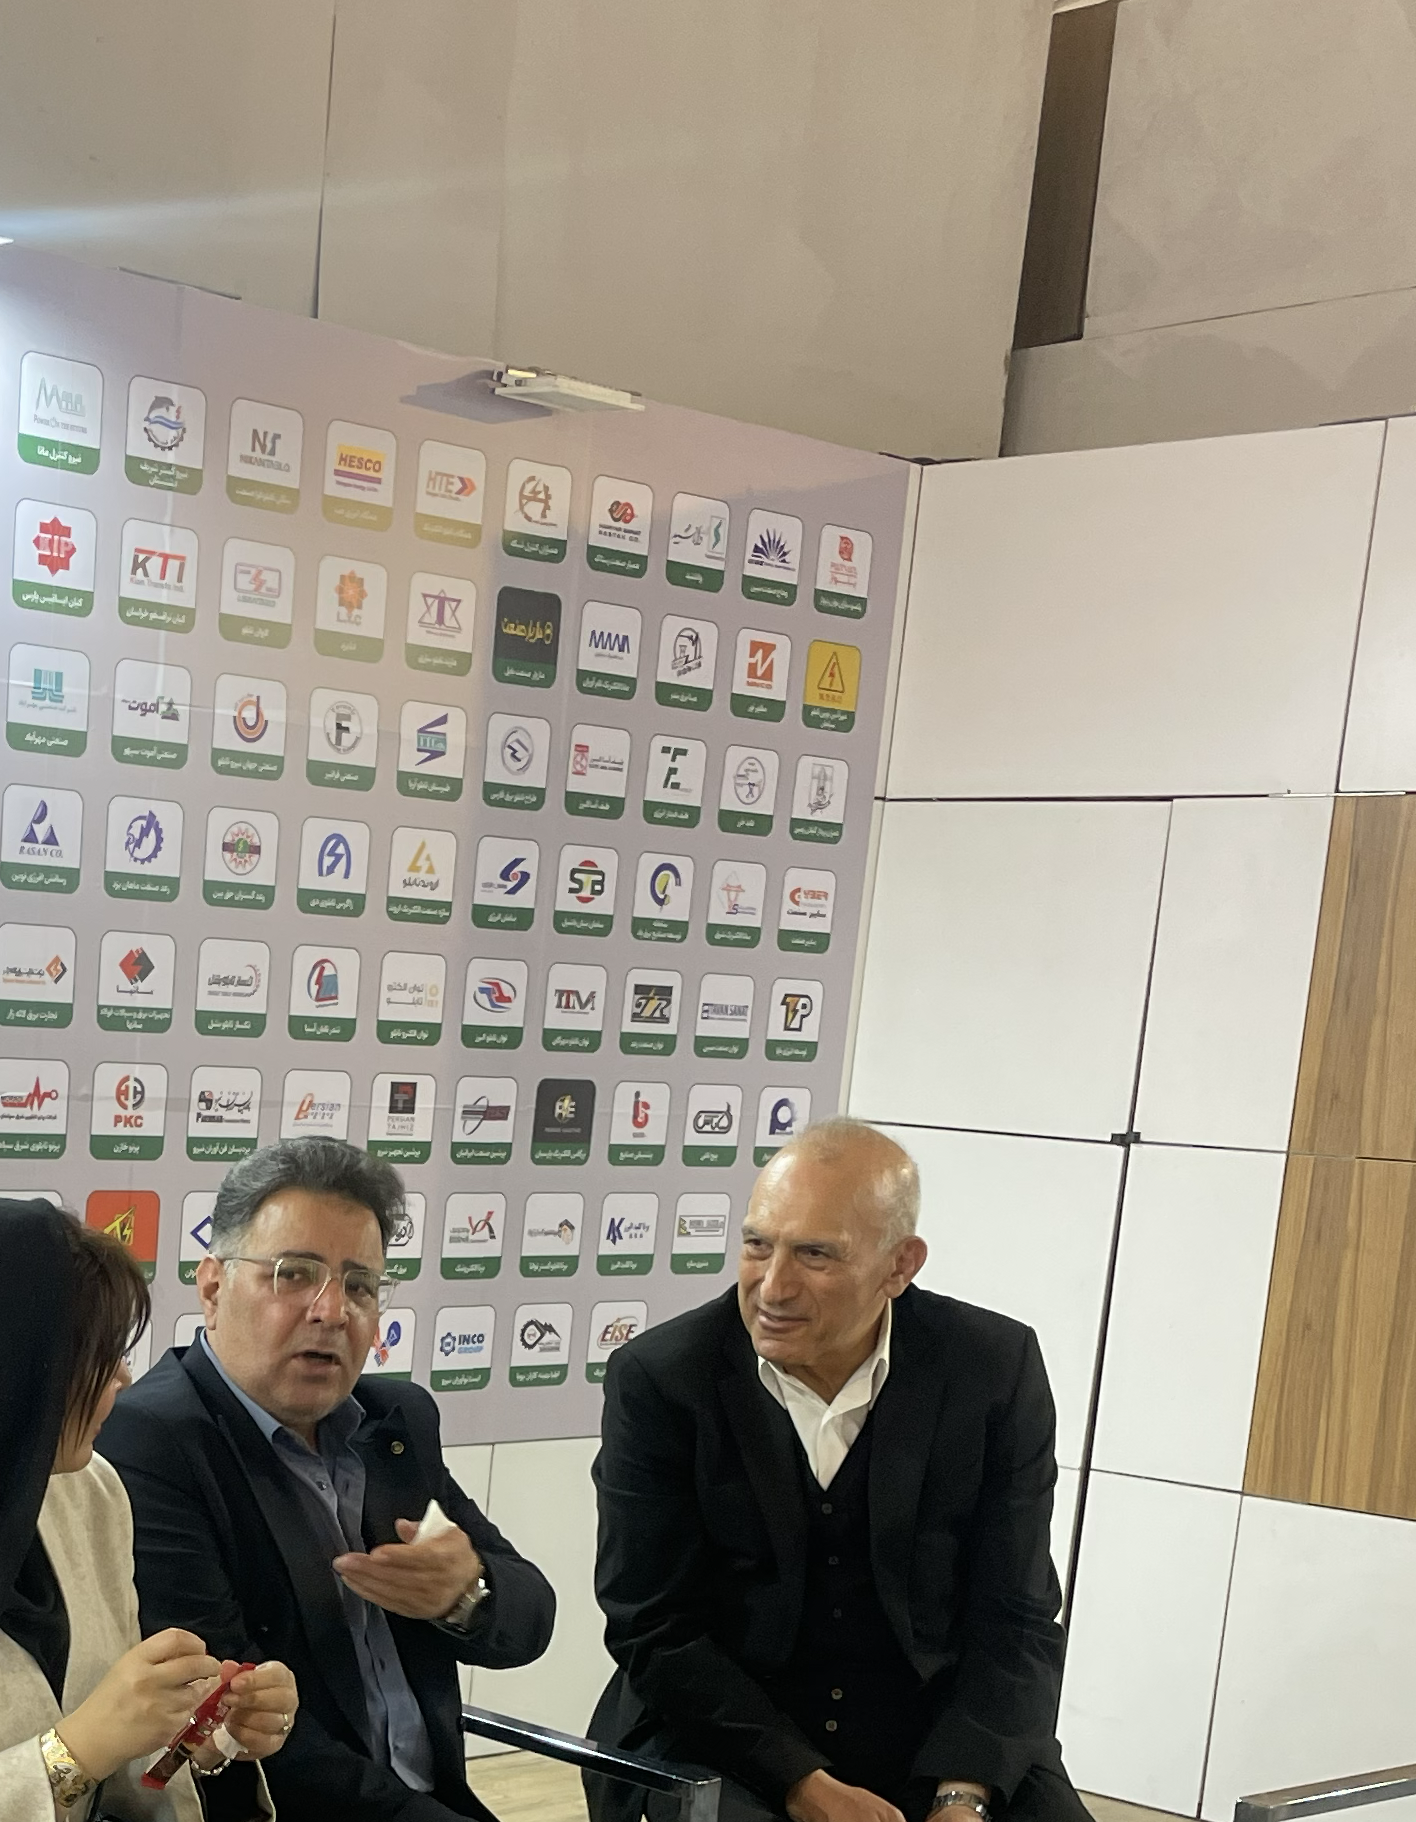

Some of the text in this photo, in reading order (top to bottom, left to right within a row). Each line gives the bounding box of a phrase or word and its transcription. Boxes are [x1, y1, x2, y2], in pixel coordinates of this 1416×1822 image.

[338, 452, 382, 474] HESCO
[114, 1114, 144, 1128] PKC
[458, 1333, 484, 1346] INCO
